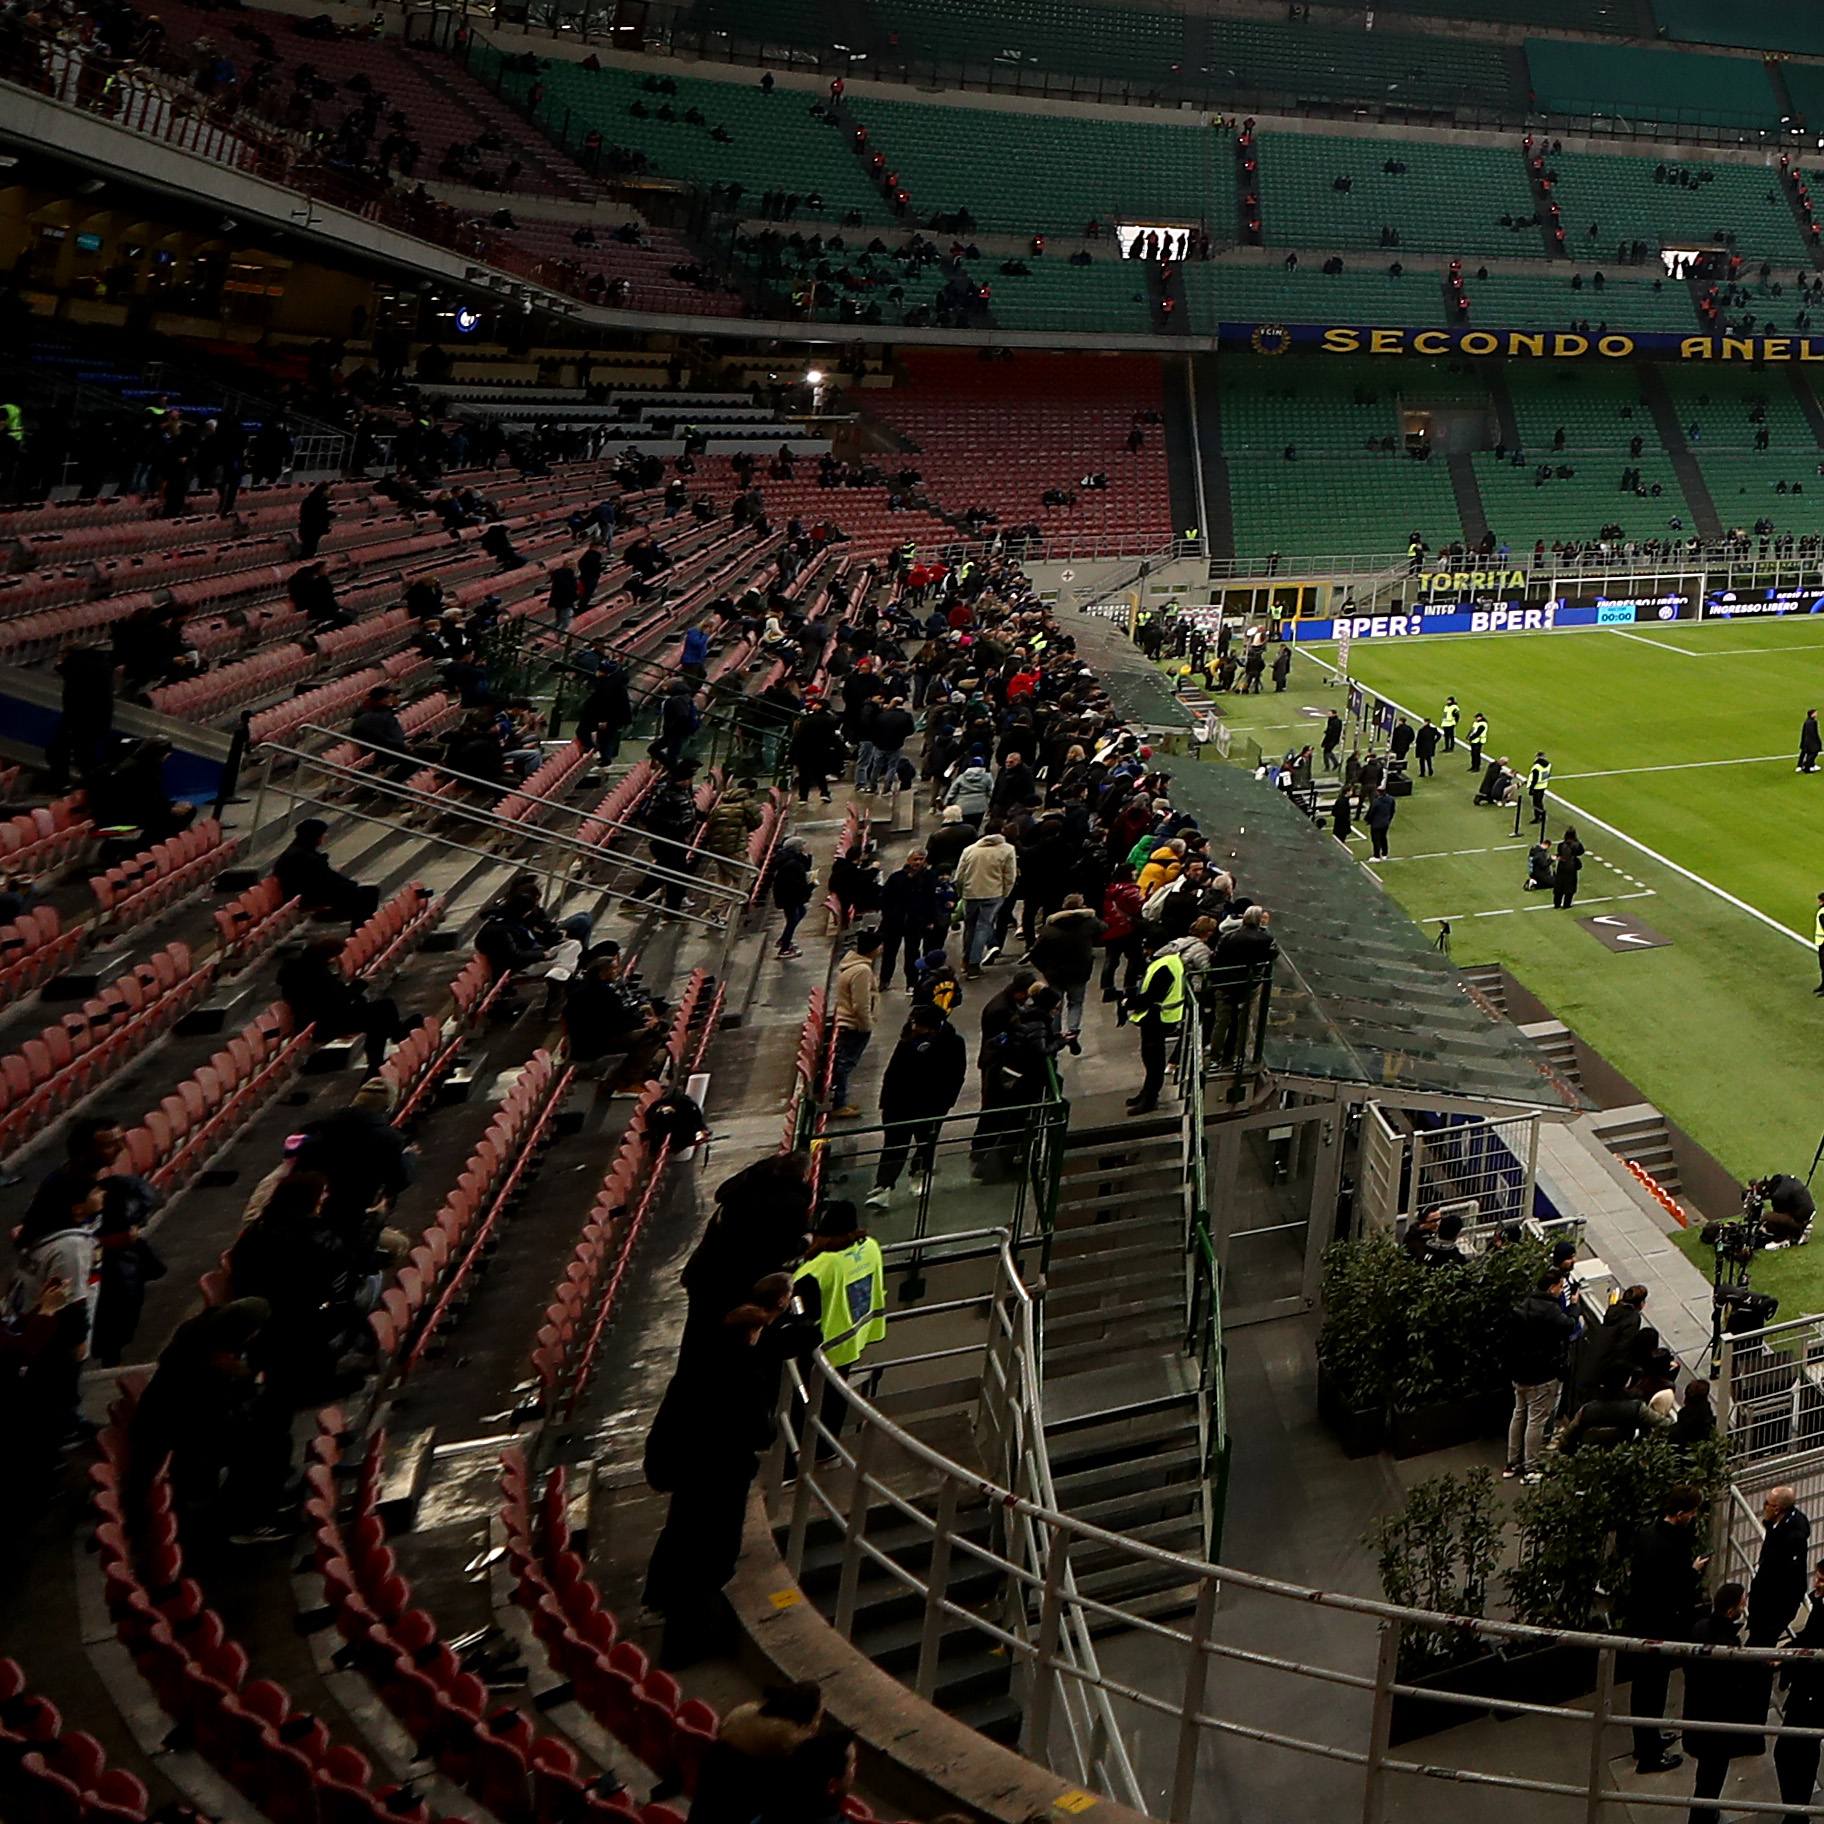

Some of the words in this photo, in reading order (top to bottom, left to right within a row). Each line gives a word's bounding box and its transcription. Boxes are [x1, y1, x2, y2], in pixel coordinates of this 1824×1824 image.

[1321, 328, 1634, 357] SECONDO
[1417, 570, 1526, 592] TORRITA
[1601, 612, 1631, 622] 00:00
[1709, 603, 1762, 615] INGRESSO
[1762, 601, 1799, 613] LIBERO
